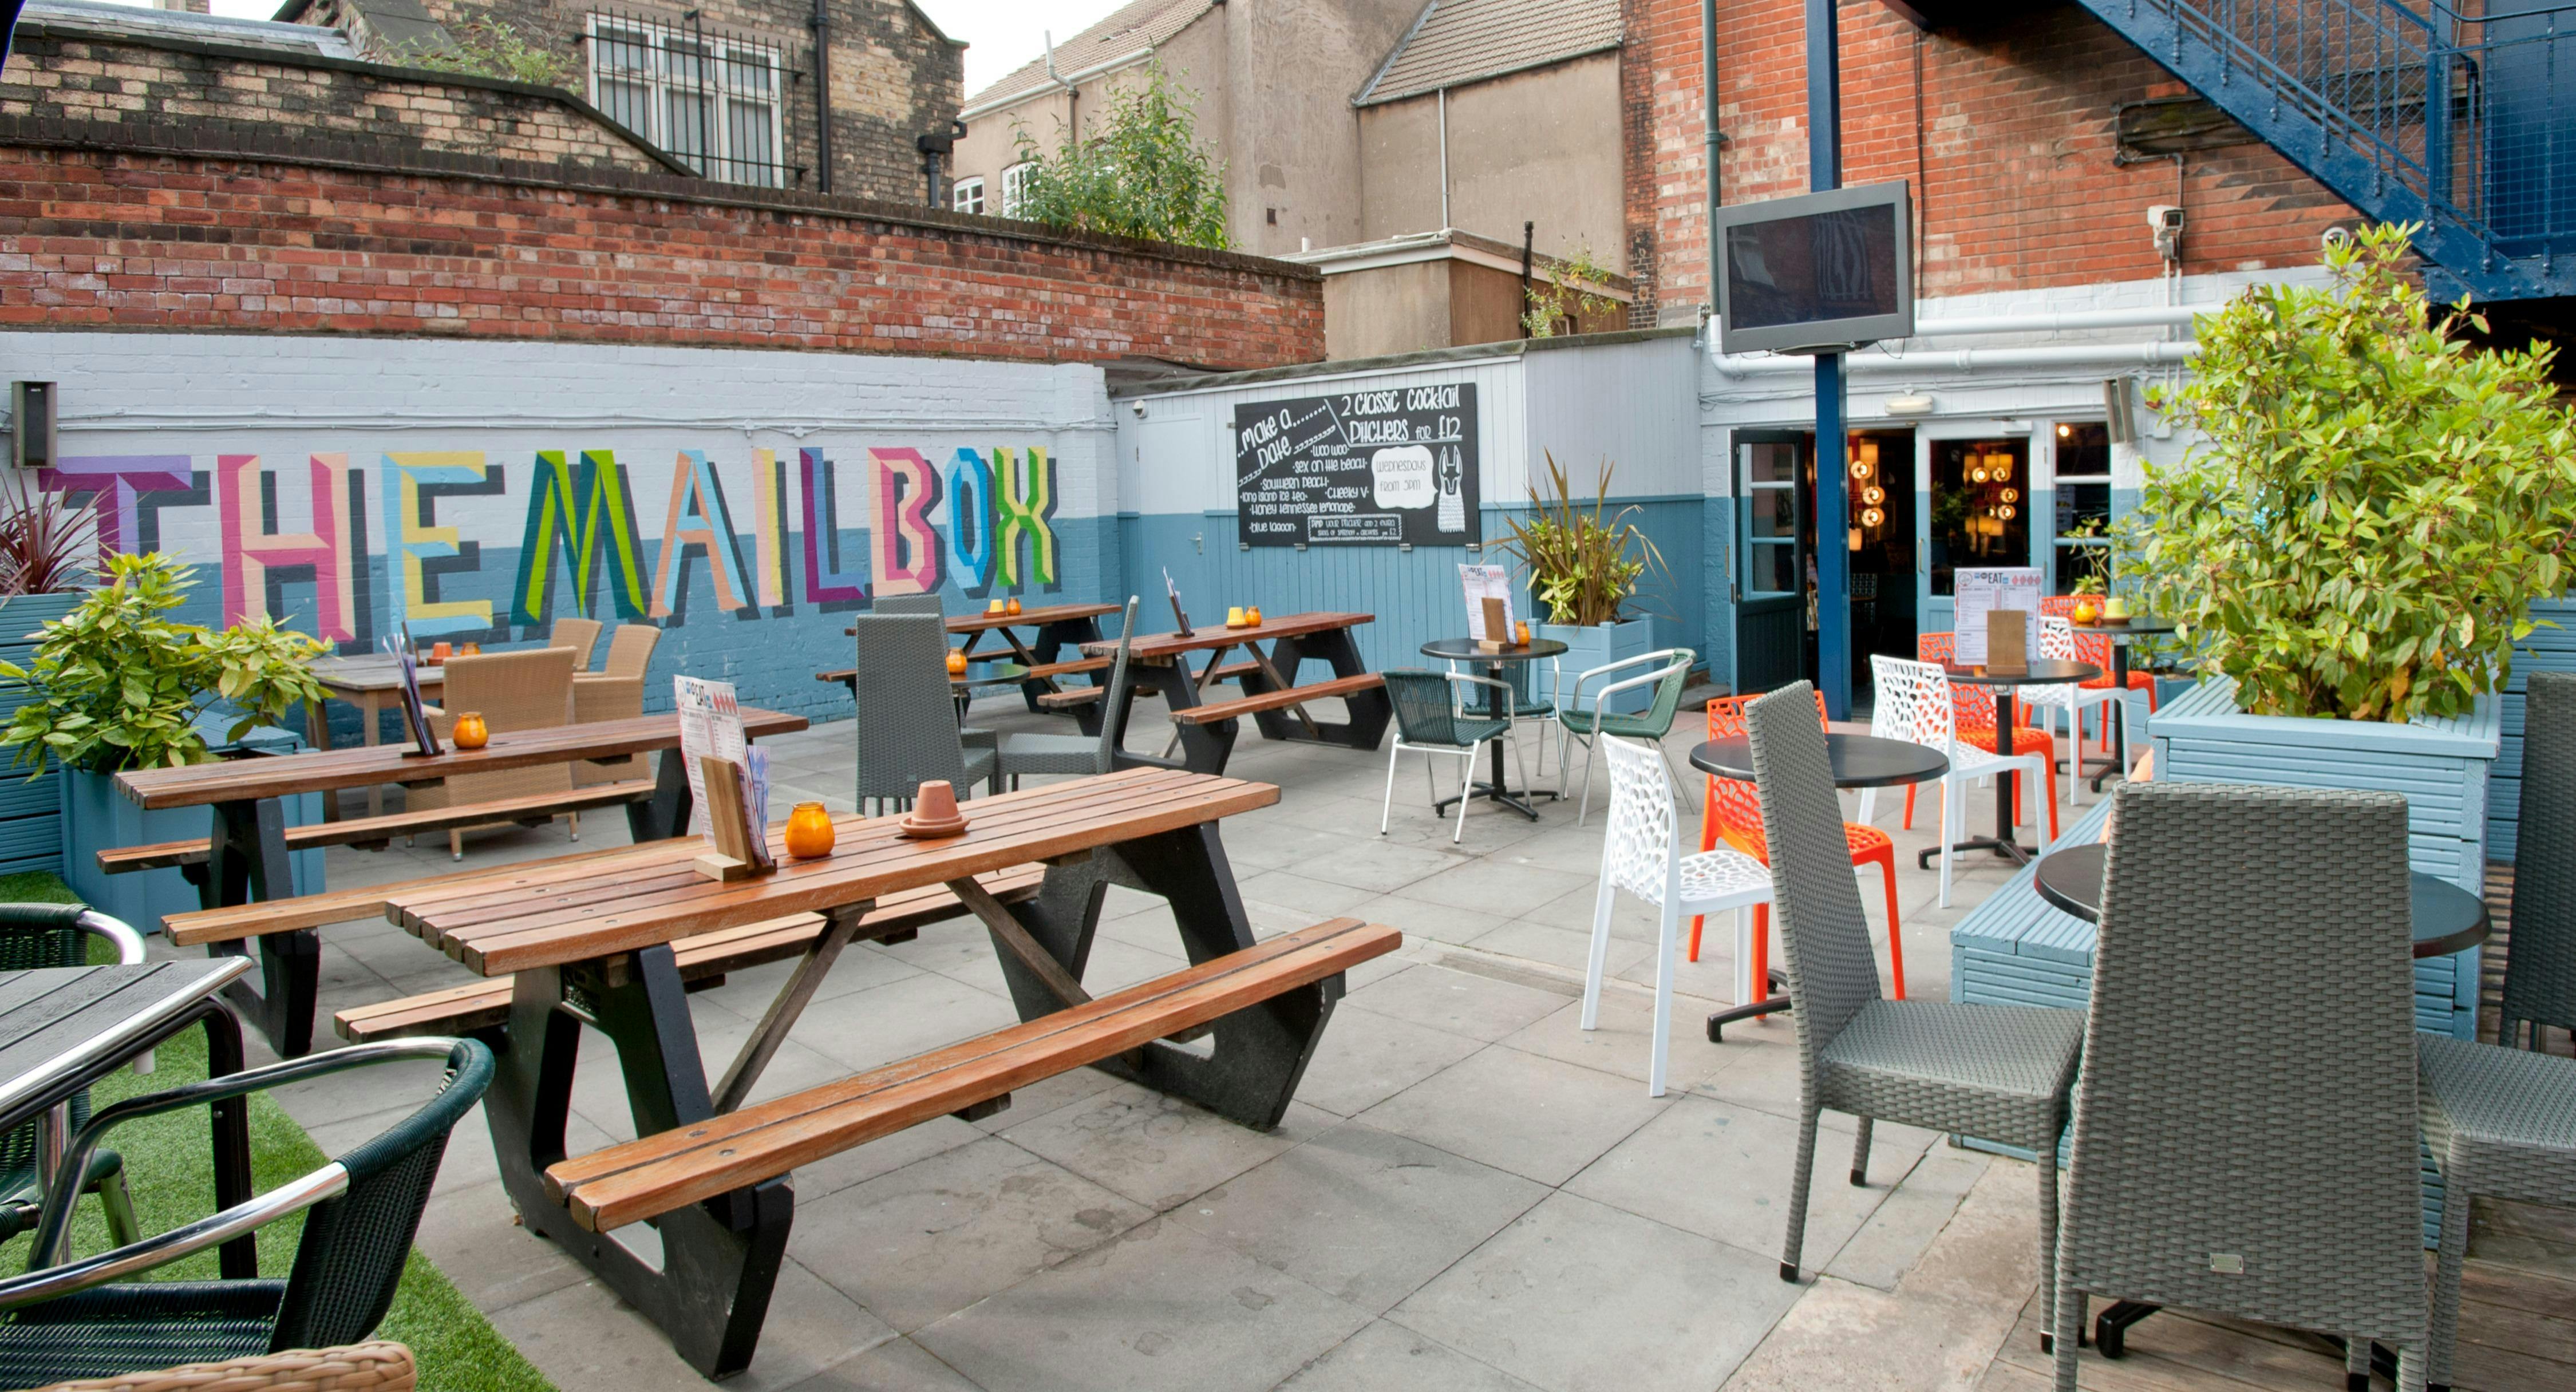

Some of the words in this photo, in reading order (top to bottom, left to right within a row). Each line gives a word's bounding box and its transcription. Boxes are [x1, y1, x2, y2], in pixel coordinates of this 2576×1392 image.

[1341, 396, 1352, 417] 2
[1439, 415, 1463, 440] £12
[1311, 460, 1324, 472] on
[1360, 486, 1368, 499] V
[1988, 572, 2004, 584] EAT
